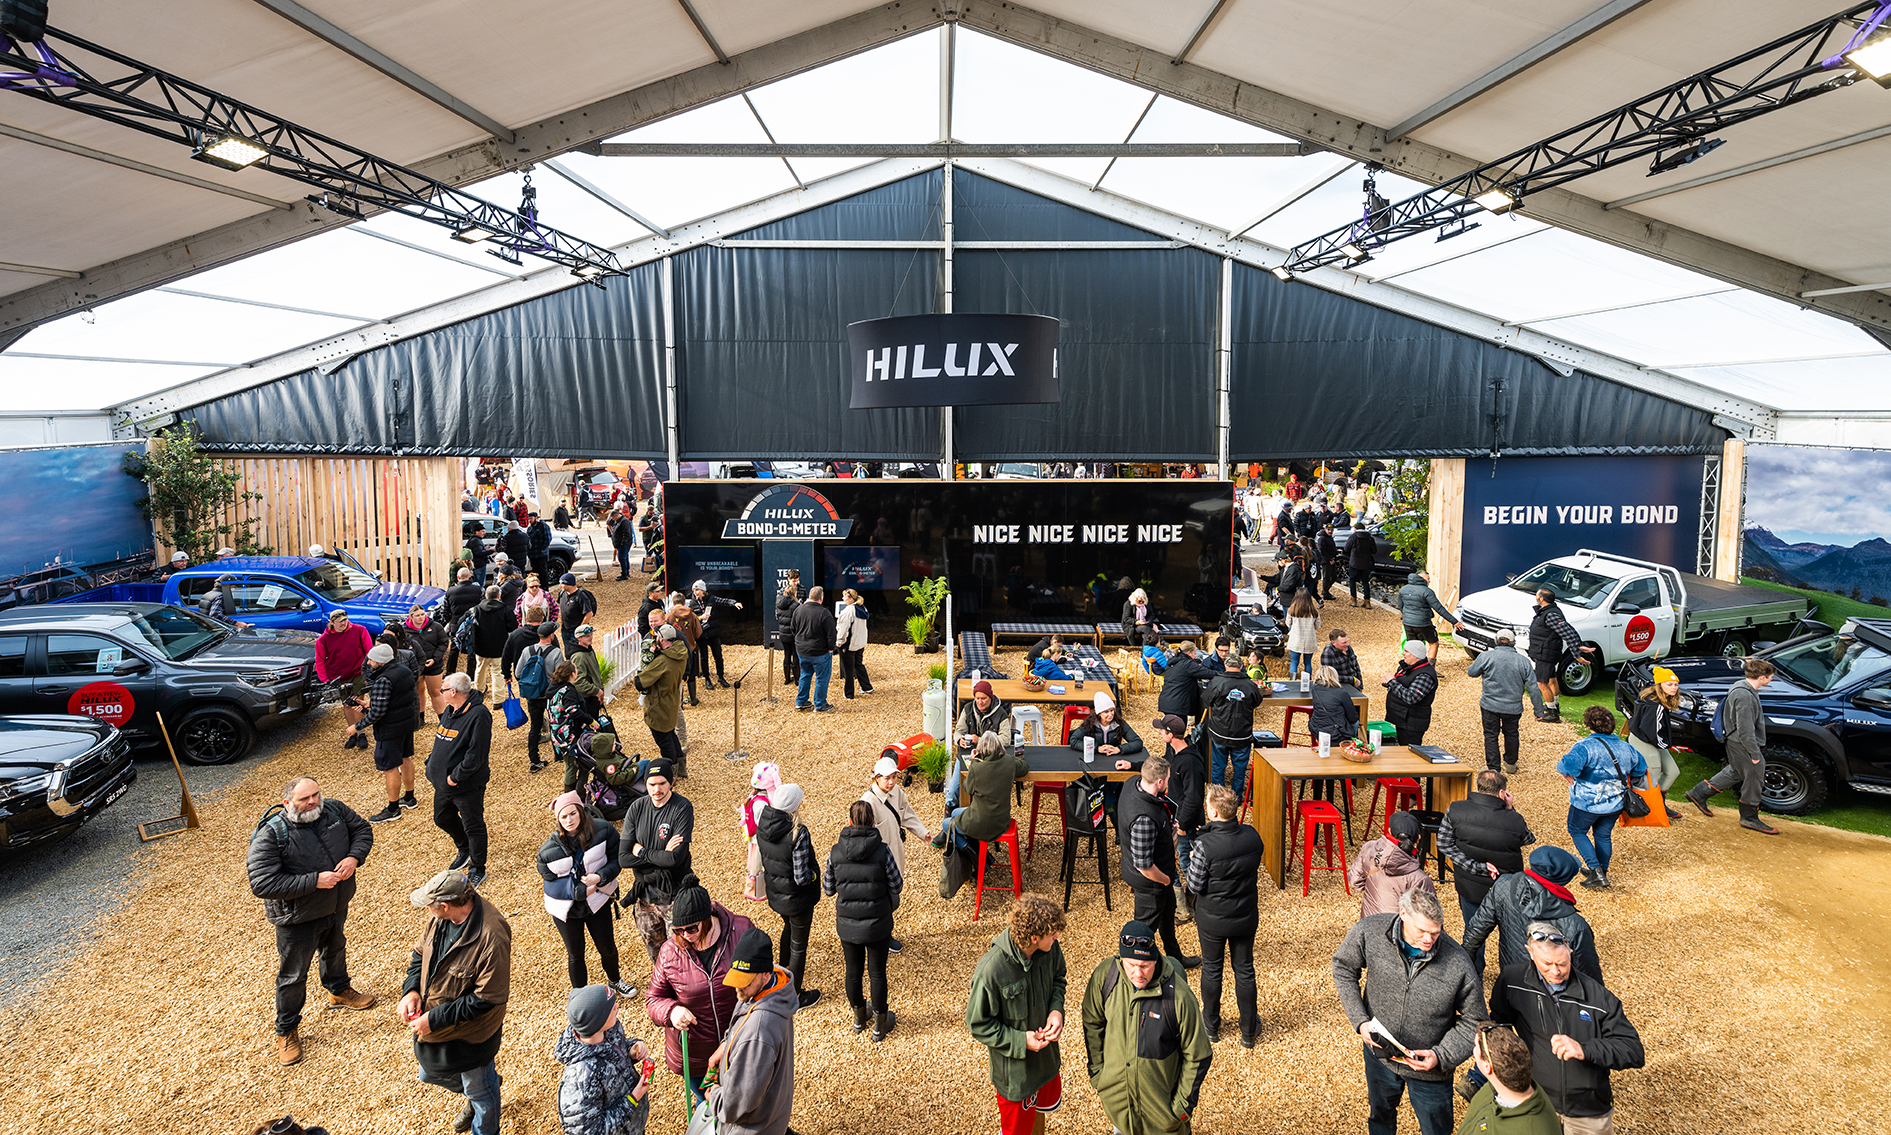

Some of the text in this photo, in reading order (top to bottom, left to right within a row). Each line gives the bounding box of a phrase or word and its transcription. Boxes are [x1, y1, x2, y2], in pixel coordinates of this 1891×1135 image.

[865, 342, 1019, 382] HILUX
[764, 508, 814, 519] HILUX
[1483, 505, 1679, 525] BEGIN YOUR BOND
[737, 522, 837, 535] BOND-O-METER
[973, 524, 1184, 544] NICE NICE NICE NICE
[81, 696, 120, 704] HILUX
[81, 704, 122, 715] $1,500
[1846, 718, 1877, 726] HILUX
